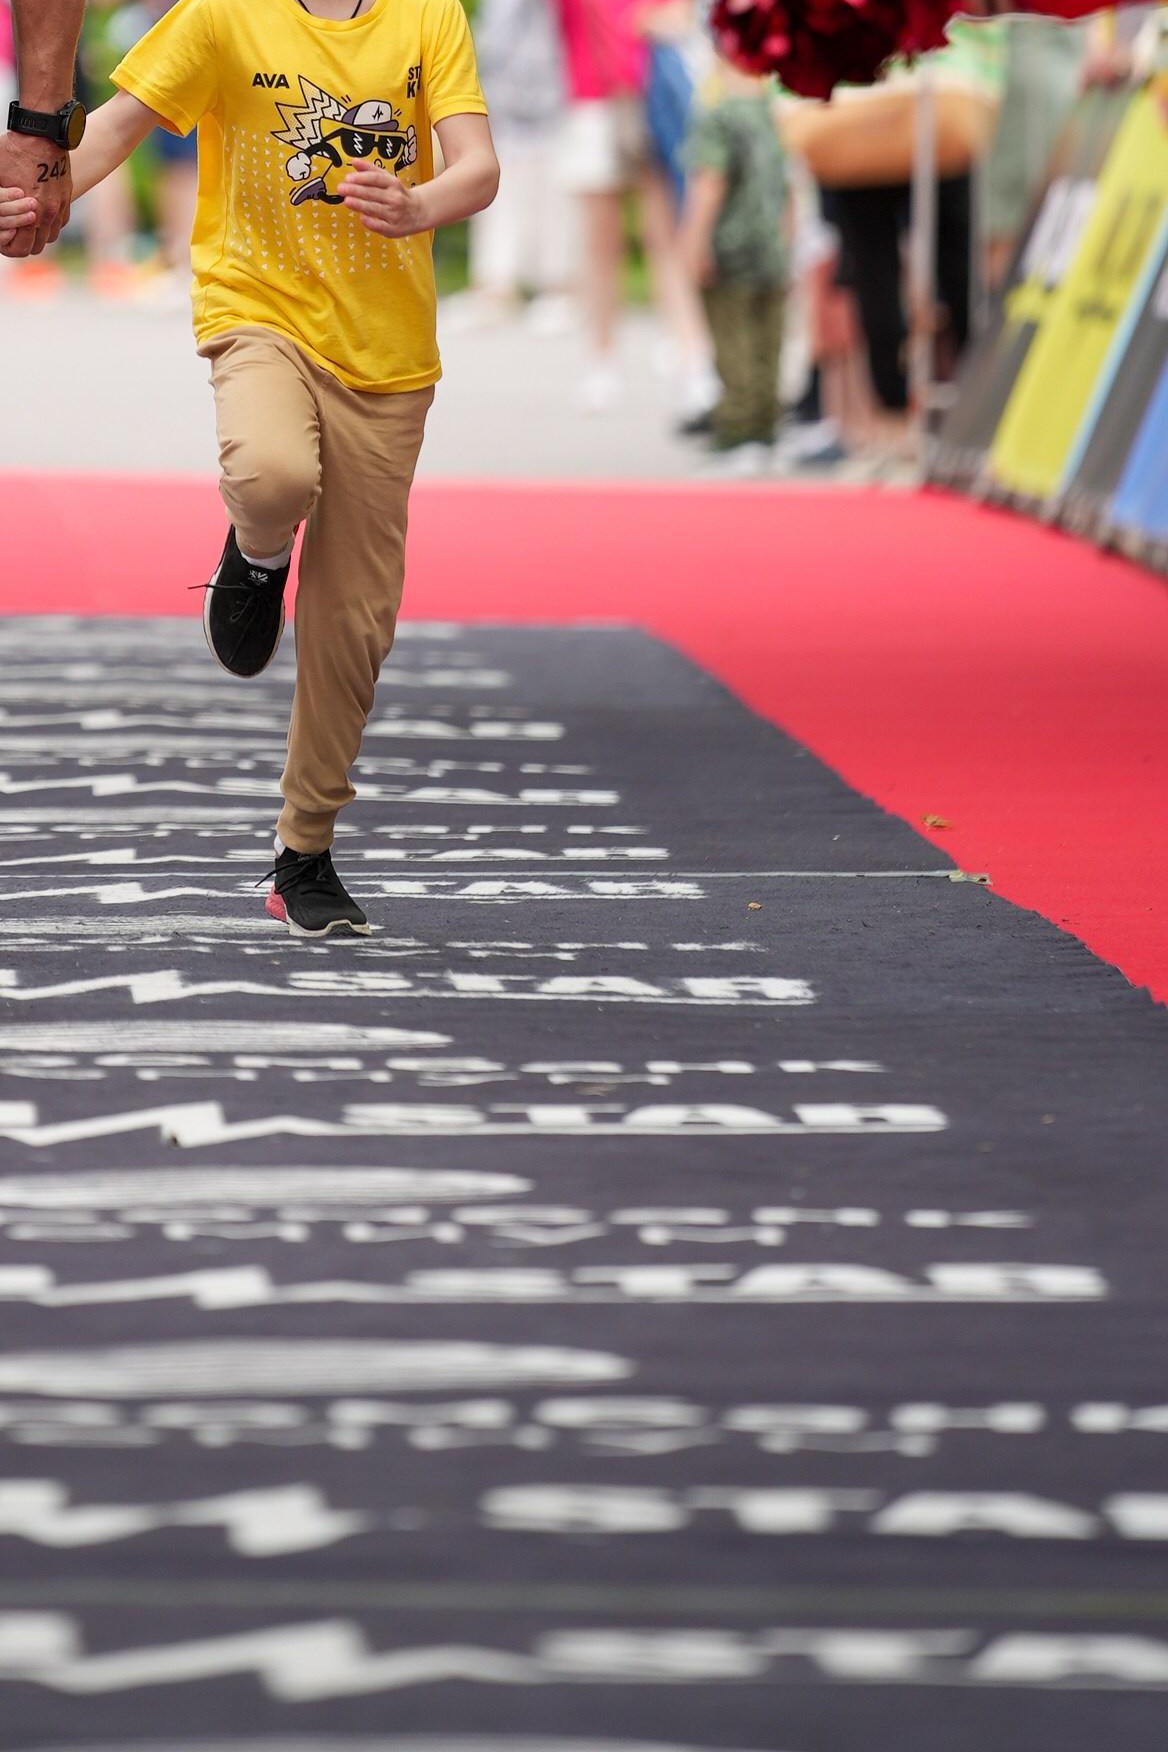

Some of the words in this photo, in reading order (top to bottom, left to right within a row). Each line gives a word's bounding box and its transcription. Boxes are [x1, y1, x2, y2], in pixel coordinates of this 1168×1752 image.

[251, 72, 290, 89] AVA
[37, 156, 67, 183] 242
[288, 970, 814, 999] STAR
[342, 1102, 949, 1131] STAR
[405, 1262, 1109, 1298] STAR
